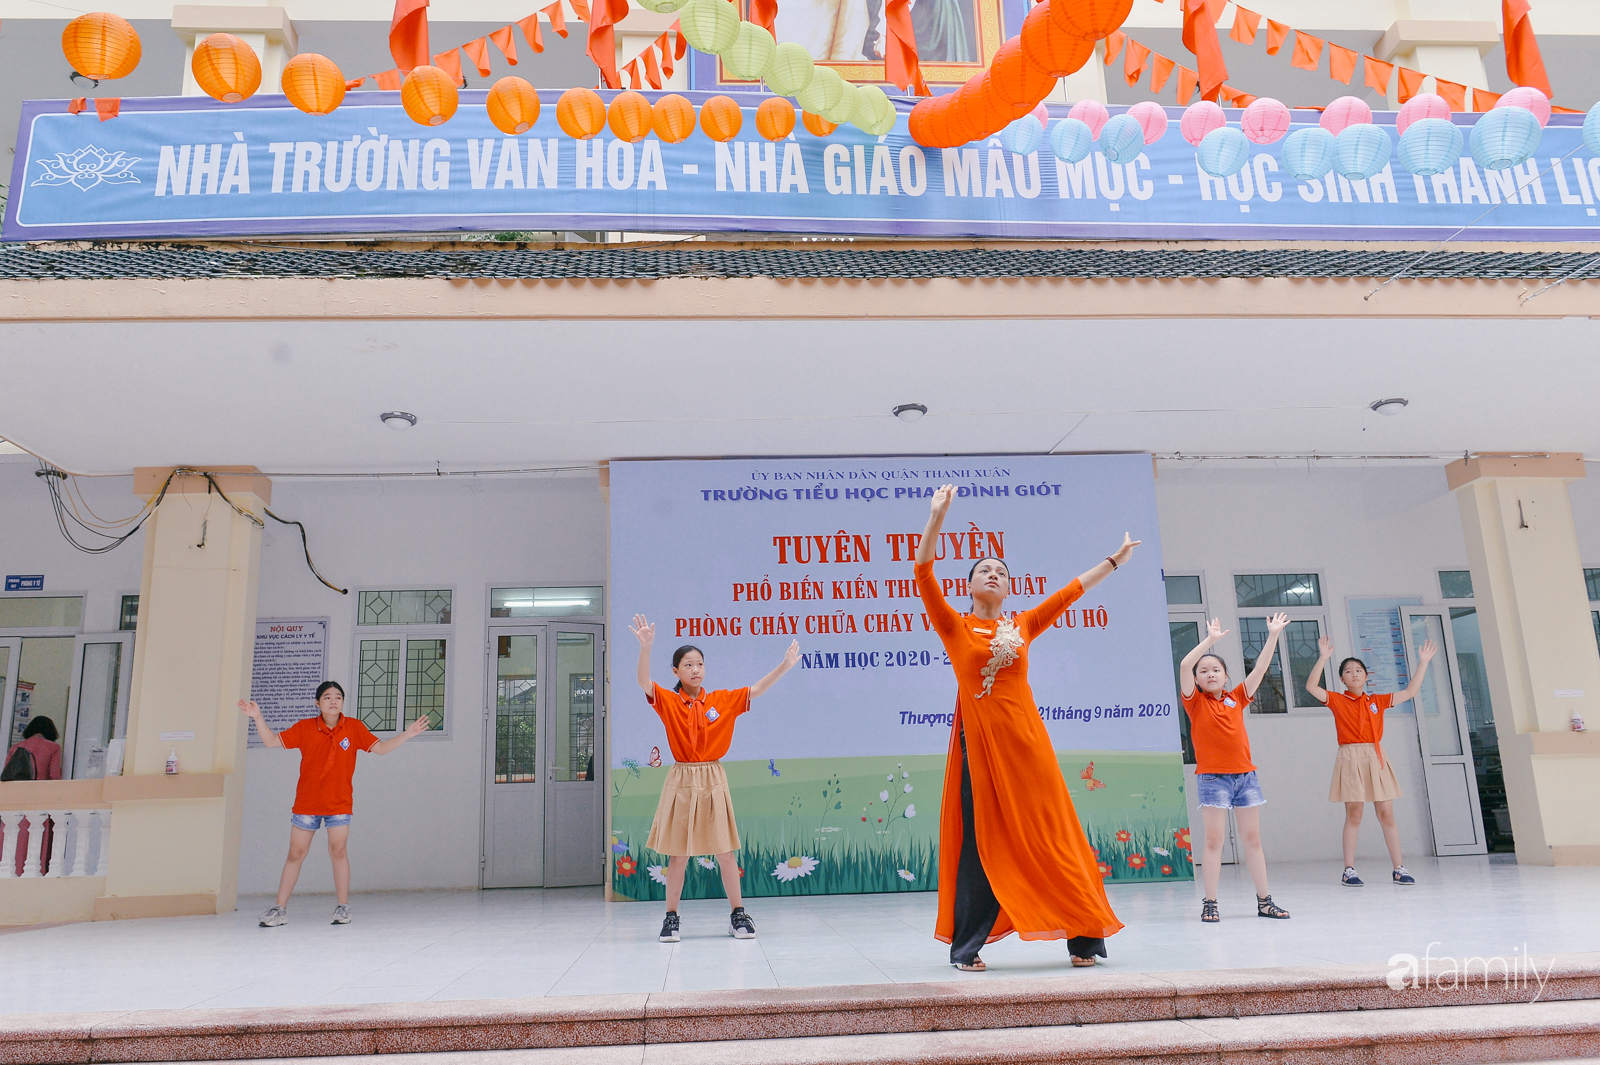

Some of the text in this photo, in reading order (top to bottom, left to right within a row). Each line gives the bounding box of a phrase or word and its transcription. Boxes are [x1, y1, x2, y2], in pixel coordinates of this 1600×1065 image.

[155, 132, 250, 197] NHÀ
[268, 127, 451, 194] TRƯỜNG
[714, 132, 810, 194] NHÀ
[823, 134, 927, 197] GIÁO
[751, 467, 1011, 481] ỦY BAN NHÂN DÂN QUẬN THANH XUÂN
[700, 480, 1062, 503] TRƯỜNG TIỂU HỌC PHA ĐÌNH GIÓT
[772, 529, 871, 565] TUYÊN
[732, 573, 772, 602] PHỔ
[779, 574, 824, 601] BIẾN
[832, 573, 879, 600] KIẾN
[1008, 573, 1047, 598] UẬT
[270, 624, 285, 633] NỘI
[674, 613, 742, 638] PHÒNG
[750, 611, 800, 636] CHÁY
[804, 609, 858, 635] CHỮA
[863, 609, 914, 633] CHÁY
[1082, 604, 1109, 630] HỘ
[801, 650, 840, 669] NĂM
[844, 651, 880, 671] HỌC
[899, 710, 955, 728] Thượng
[1052, 705, 1092, 723] tháng
[1094, 705, 1102, 719] 9
[1104, 704, 1134, 719] năm
[1138, 703, 1171, 718] 2020
